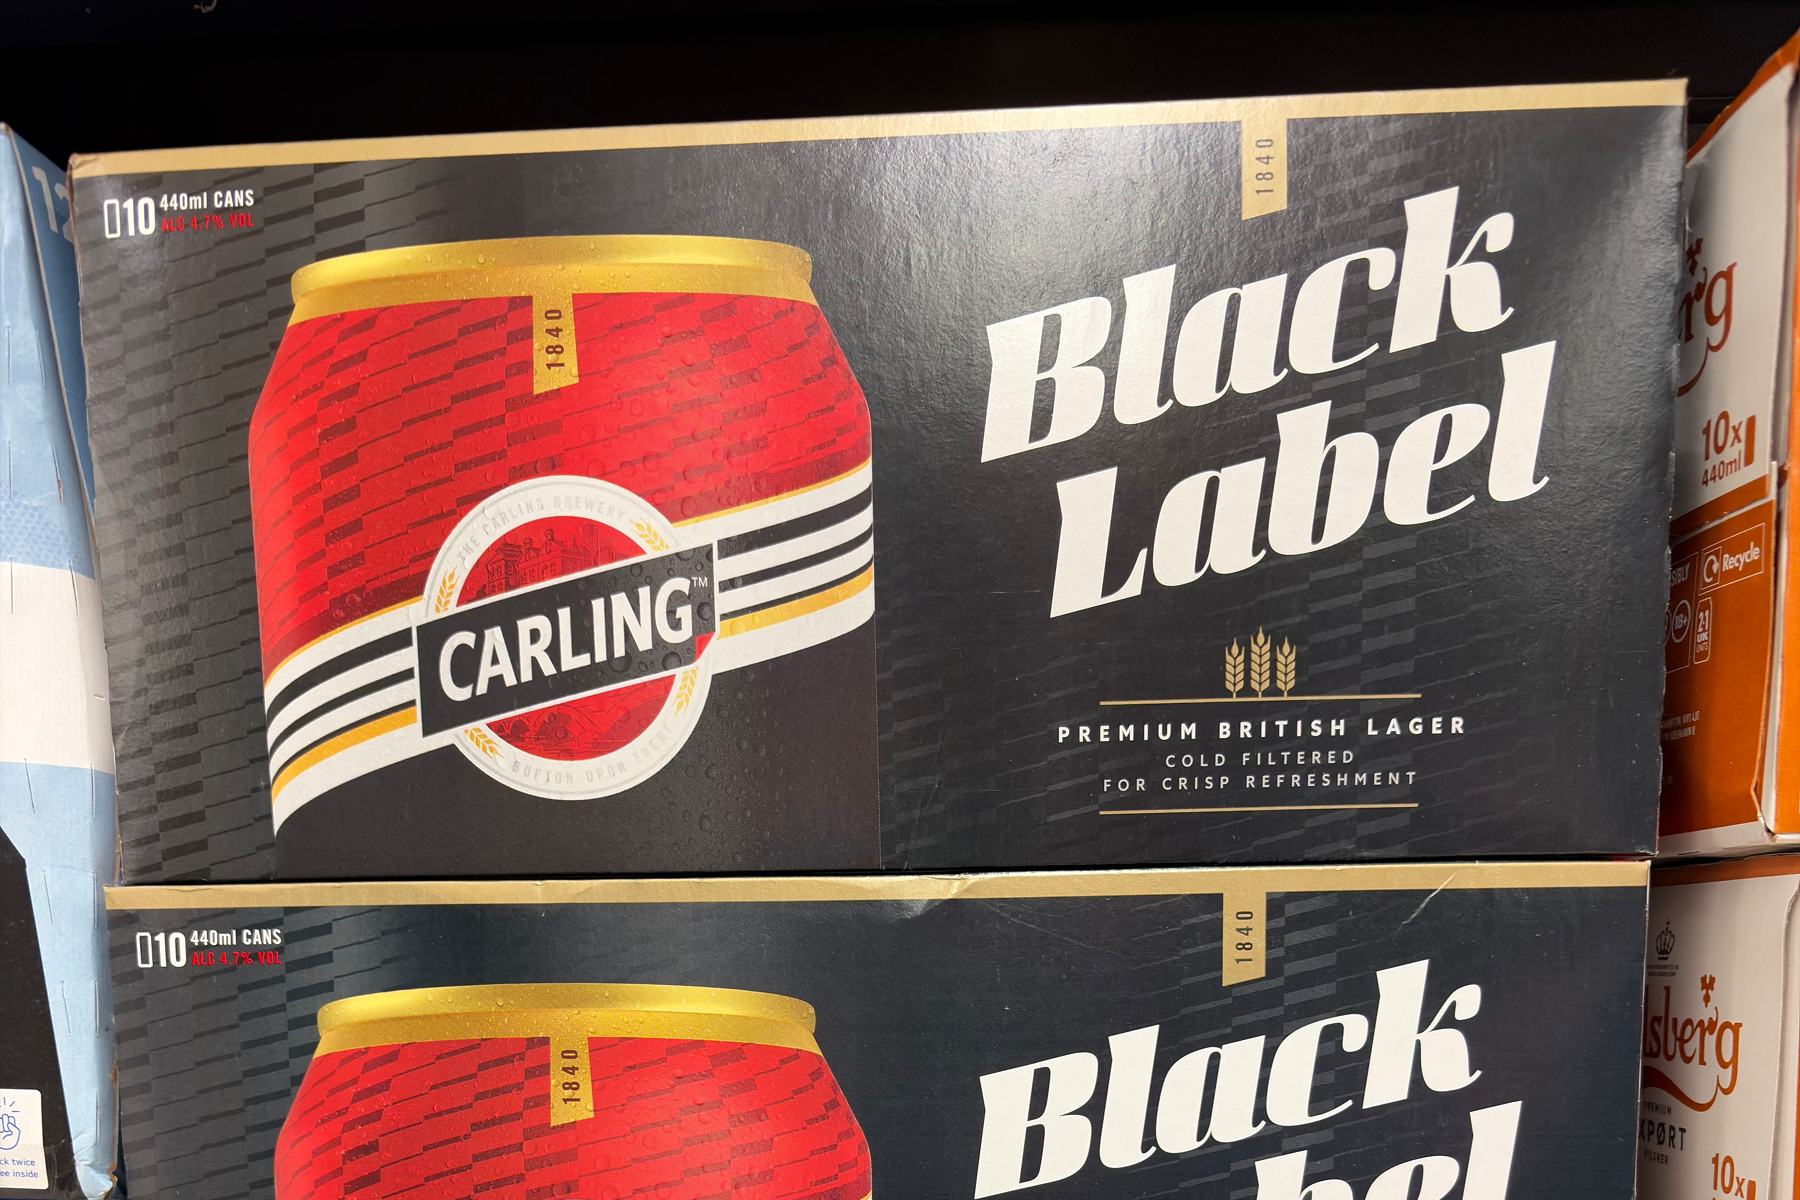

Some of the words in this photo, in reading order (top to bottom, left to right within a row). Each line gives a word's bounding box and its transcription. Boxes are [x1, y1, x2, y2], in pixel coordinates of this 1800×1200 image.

[1255, 138, 1274, 196] 1840
[124, 197, 155, 237] 10
[160, 192, 208, 211] 440ml
[214, 189, 254, 208] CANS
[161, 216, 185, 233] ALC
[190, 214, 224, 231] 4.7%
[229, 212, 254, 228] VOL
[544, 309, 565, 370] 1840
[981, 186, 1515, 463] Black
[1702, 410, 1743, 461] 10x
[1050, 340, 1557, 618] Label
[1702, 451, 1741, 487] 440ml
[457, 536, 481, 563] THE
[482, 498, 545, 535] CARLING
[553, 496, 625, 521] BREWERY
[1722, 541, 1760, 572] Recycle
[439, 577, 693, 702] CARLING
[1058, 723, 1197, 743] PREMIUM
[1218, 719, 1345, 739] BRITISH
[1367, 717, 1465, 736] LAGER
[585, 763, 628, 783] UPON
[1103, 778, 1146, 792] FOR
[1162, 776, 1230, 791] CRISP
[1246, 771, 1418, 789] REFRESHMENT
[1165, 754, 1226, 768] COLD
[1242, 750, 1354, 766] FILTERED
[154, 932, 187, 967] 10
[190, 929, 236, 946] 440ml
[242, 929, 282, 945] CANS
[191, 952, 215, 966] ALC
[219, 952, 253, 965] 4.7%
[257, 951, 282, 964] VOL
[1235, 911, 1254, 965] 1840
[561, 1049, 580, 1104] 1840
[974, 959, 1482, 1200] Black
[11, 1157, 36, 1167] twice
[12, 1170, 39, 1179] inside
[1711, 1152, 1745, 1199] 10x
